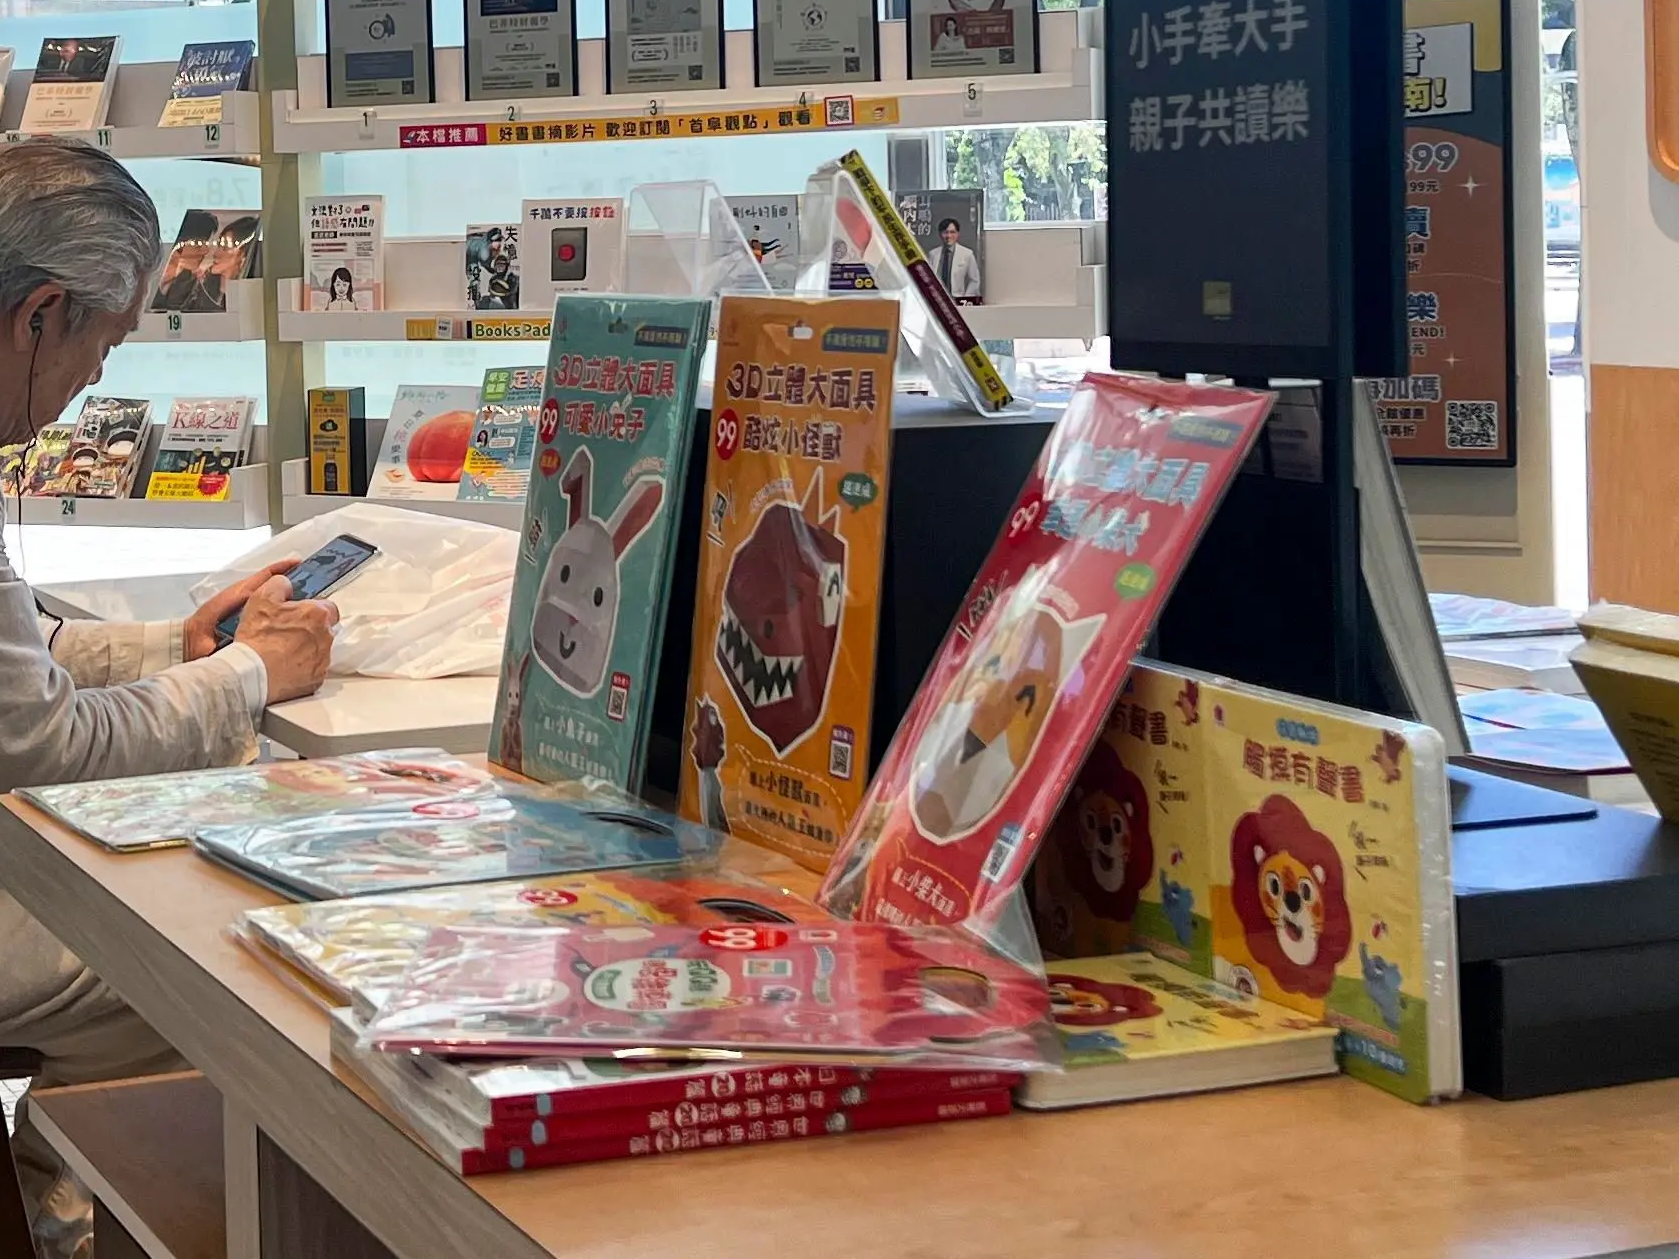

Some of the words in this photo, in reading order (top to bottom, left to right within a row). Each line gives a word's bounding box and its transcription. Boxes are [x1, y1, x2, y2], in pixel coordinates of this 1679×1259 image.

[798, 92, 807, 107] 4
[967, 83, 977, 100] 5
[507, 105, 516, 121] 2
[649, 99, 658, 116] 3
[1128, 80, 1310, 153] 親子共讀樂
[98, 131, 110, 146] 11
[205, 125, 218, 141] 12
[167, 314, 181, 330] 19
[475, 322, 551, 338] BooksPad
[1411, 327, 1445, 338] END!
[553, 353, 677, 400] 3D立體大面具
[725, 360, 878, 414] 3D立體大面具
[172, 411, 241, 430] K線之道
[541, 409, 558, 434] 99
[564, 398, 647, 443] 可愛小兔子
[717, 418, 738, 450] 99
[62, 499, 75, 514] 24
[1009, 500, 1041, 538] 99
